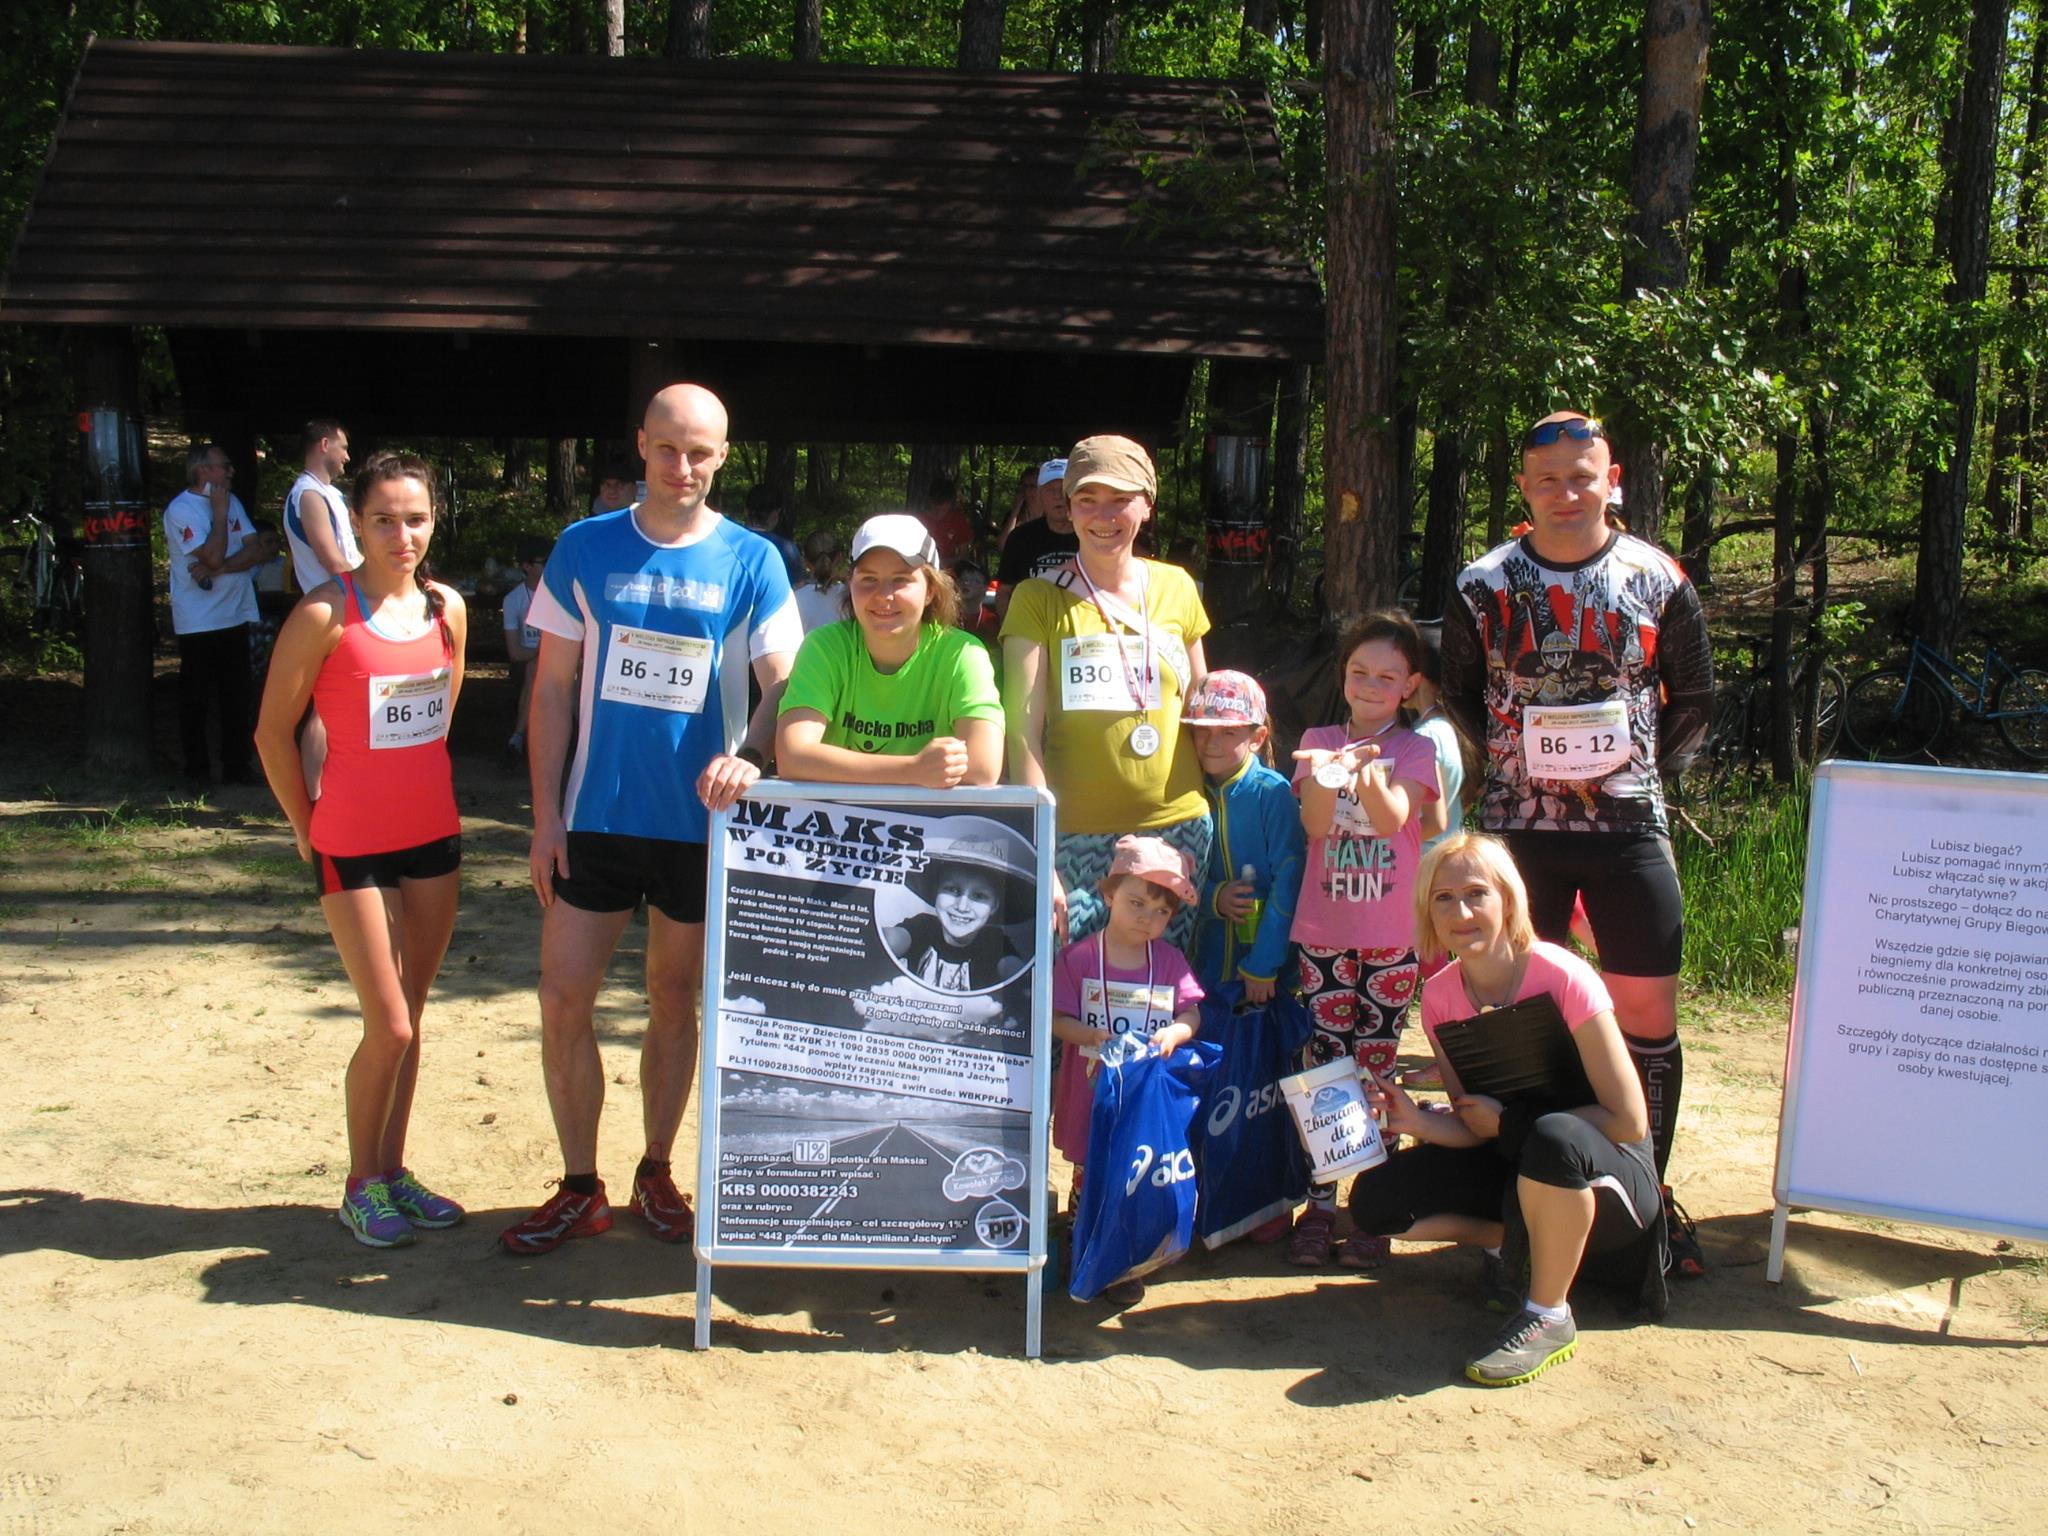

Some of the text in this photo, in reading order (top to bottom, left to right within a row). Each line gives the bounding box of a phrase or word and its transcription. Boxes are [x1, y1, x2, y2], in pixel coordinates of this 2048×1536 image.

[620, 658, 693, 687] B6 19
[1070, 666, 1112, 684] B30
[387, 698, 443, 723] B6 04
[1540, 734, 1615, 755] B6 12
[726, 826, 756, 843] W
[732, 799, 925, 851] MAKS
[744, 847, 788, 866] PO
[1324, 838, 1392, 870] HAVE
[1931, 838, 2023, 857] Lubisz biegać?
[1902, 851, 1941, 865] Lubisz
[1944, 856, 2001, 872] pomagać
[1893, 865, 2020, 887] Lubisz włączać się w
[1331, 872, 1383, 903] FUN
[1928, 884, 2017, 902] charytatywne?
[727, 896, 739, 905] Od
[740, 898, 757, 908] roku
[789, 906, 799, 914] na
[757, 890, 775, 899] Mam
[788, 893, 805, 904] imię
[830, 901, 849, 911] Mam
[1868, 893, 2033, 919] Nic prostszego dołącz do
[761, 922, 787, 934] bardzo
[838, 924, 860, 934] Przed
[1875, 908, 1961, 929] Charytatywnej
[1964, 917, 2002, 933] Grupy
[728, 929, 750, 940] Teraz
[750, 932, 788, 946] odbywam
[795, 952, 806, 961] po
[1875, 938, 1991, 961] Wszędzie gdzie się
[1870, 953, 2022, 981] biegniemy dla konkretnej
[727, 970, 751, 983] Jeśli
[753, 974, 789, 989] chcesz
[790, 979, 806, 993] się
[807, 983, 820, 993] do
[822, 986, 847, 997] mnie
[905, 1000, 963, 1015] zapraszam!
[1864, 967, 2024, 996] równocześnie prowadzimy
[1858, 981, 2024, 1010] publiczną przeznaczoną na
[865, 1007, 1026, 1039] Z góry dziękuję za każdą pomoc!
[1920, 1004, 2002, 1022] danej osobie.
[725, 1013, 944, 1055] Fundacja Pomocy Dzieciom Osobom Chorym
[1837, 1023, 2040, 1058] Szczegóły dotyczące działalności
[739, 1036, 964, 1078] Tytułem: pomoc leczeniu Maksymiliana
[756, 1028, 780, 1039] Bank
[783, 1033, 796, 1042] BZ
[799, 1036, 822, 1046] WBK
[825, 1039, 836, 1048] 31
[840, 1041, 863, 1051] 1090
[892, 1049, 916, 1060] 0000
[919, 1053, 942, 1064] 0001
[945, 1058, 969, 1069] 2173
[972, 1062, 996, 1073] 1374
[1848, 1042, 2037, 1074] grupy zapisy do nas dostępne
[824, 1059, 921, 1082] wpłaty zagraniczne:
[1897, 1061, 2013, 1086] osoby kwestującej.
[902, 1081, 926, 1093] swift
[929, 1087, 956, 1098] code:
[1644, 1057, 1673, 1150] alenji
[1303, 1099, 1365, 1134] Zbieramy
[1331, 1122, 1356, 1143] dla
[1321, 1129, 1377, 1167] Maksia!
[722, 1153, 741, 1163] Aby
[743, 1153, 792, 1164] przekazać
[830, 1155, 870, 1166] podatku
[872, 1156, 888, 1165] dla
[890, 1156, 928, 1165] Maksia:
[721, 1168, 753, 1179] należy
[766, 1168, 819, 1178] formularzu
[820, 1169, 837, 1178] PIT
[839, 1170, 874, 1181] wpisać
[722, 1183, 858, 1198] KRS 0000382243
[721, 1202, 793, 1213] oraz rubryce
[782, 1218, 945, 1230] uzupełniające cel szczegółowy
[720, 1231, 910, 1244] wpisać pomoc dla Maksymiliana
